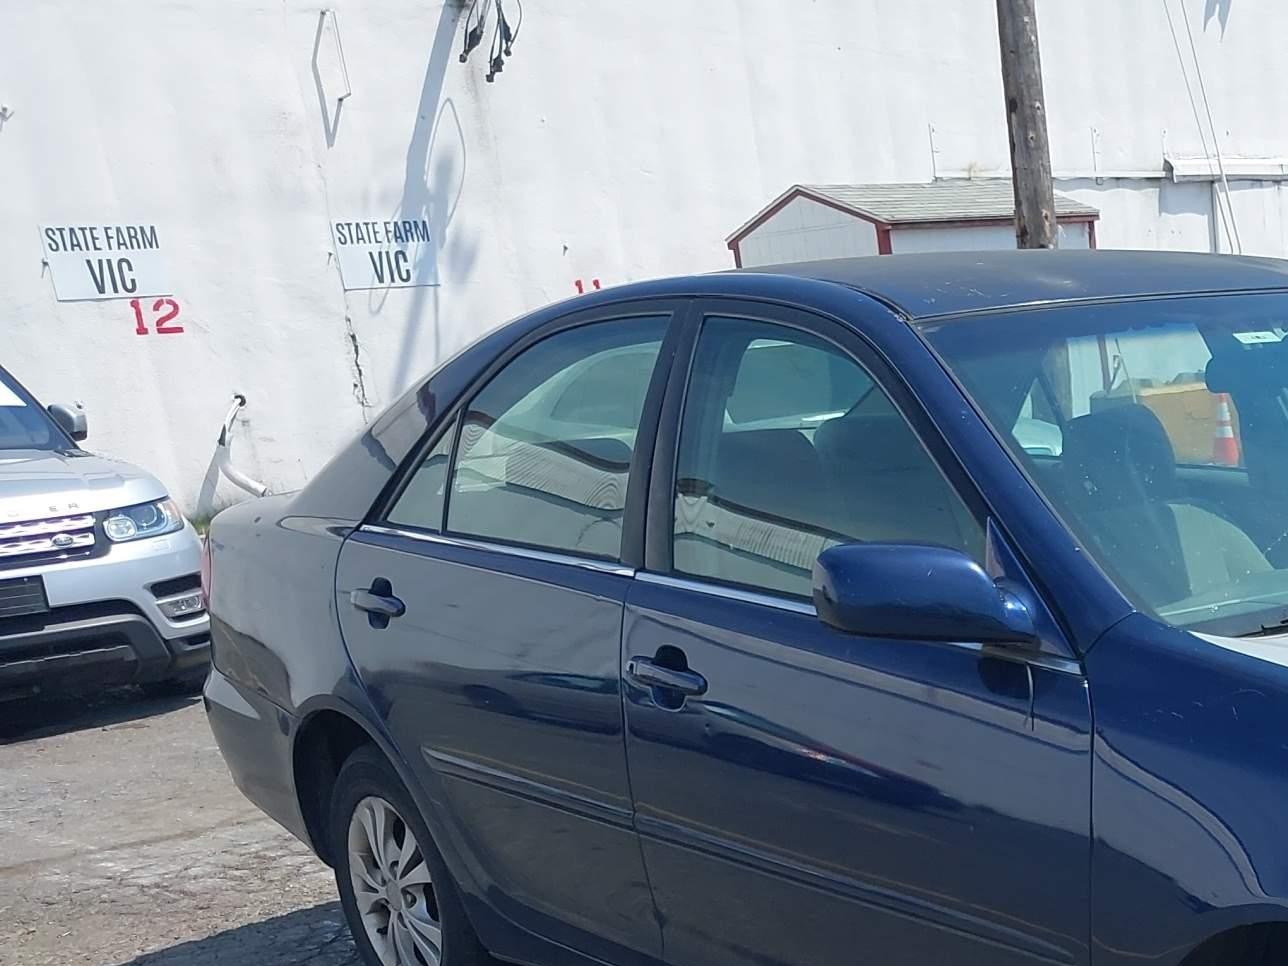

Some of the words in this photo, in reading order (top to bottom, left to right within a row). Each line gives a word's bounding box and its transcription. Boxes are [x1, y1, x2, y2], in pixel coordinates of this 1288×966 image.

[45, 226, 102, 252] STATE
[103, 225, 160, 251] FARM
[336, 222, 383, 245] STATE
[384, 220, 430, 244] FARM
[86, 257, 137, 295] VIC
[369, 250, 411, 284] VIC
[131, 298, 185, 335] 12
